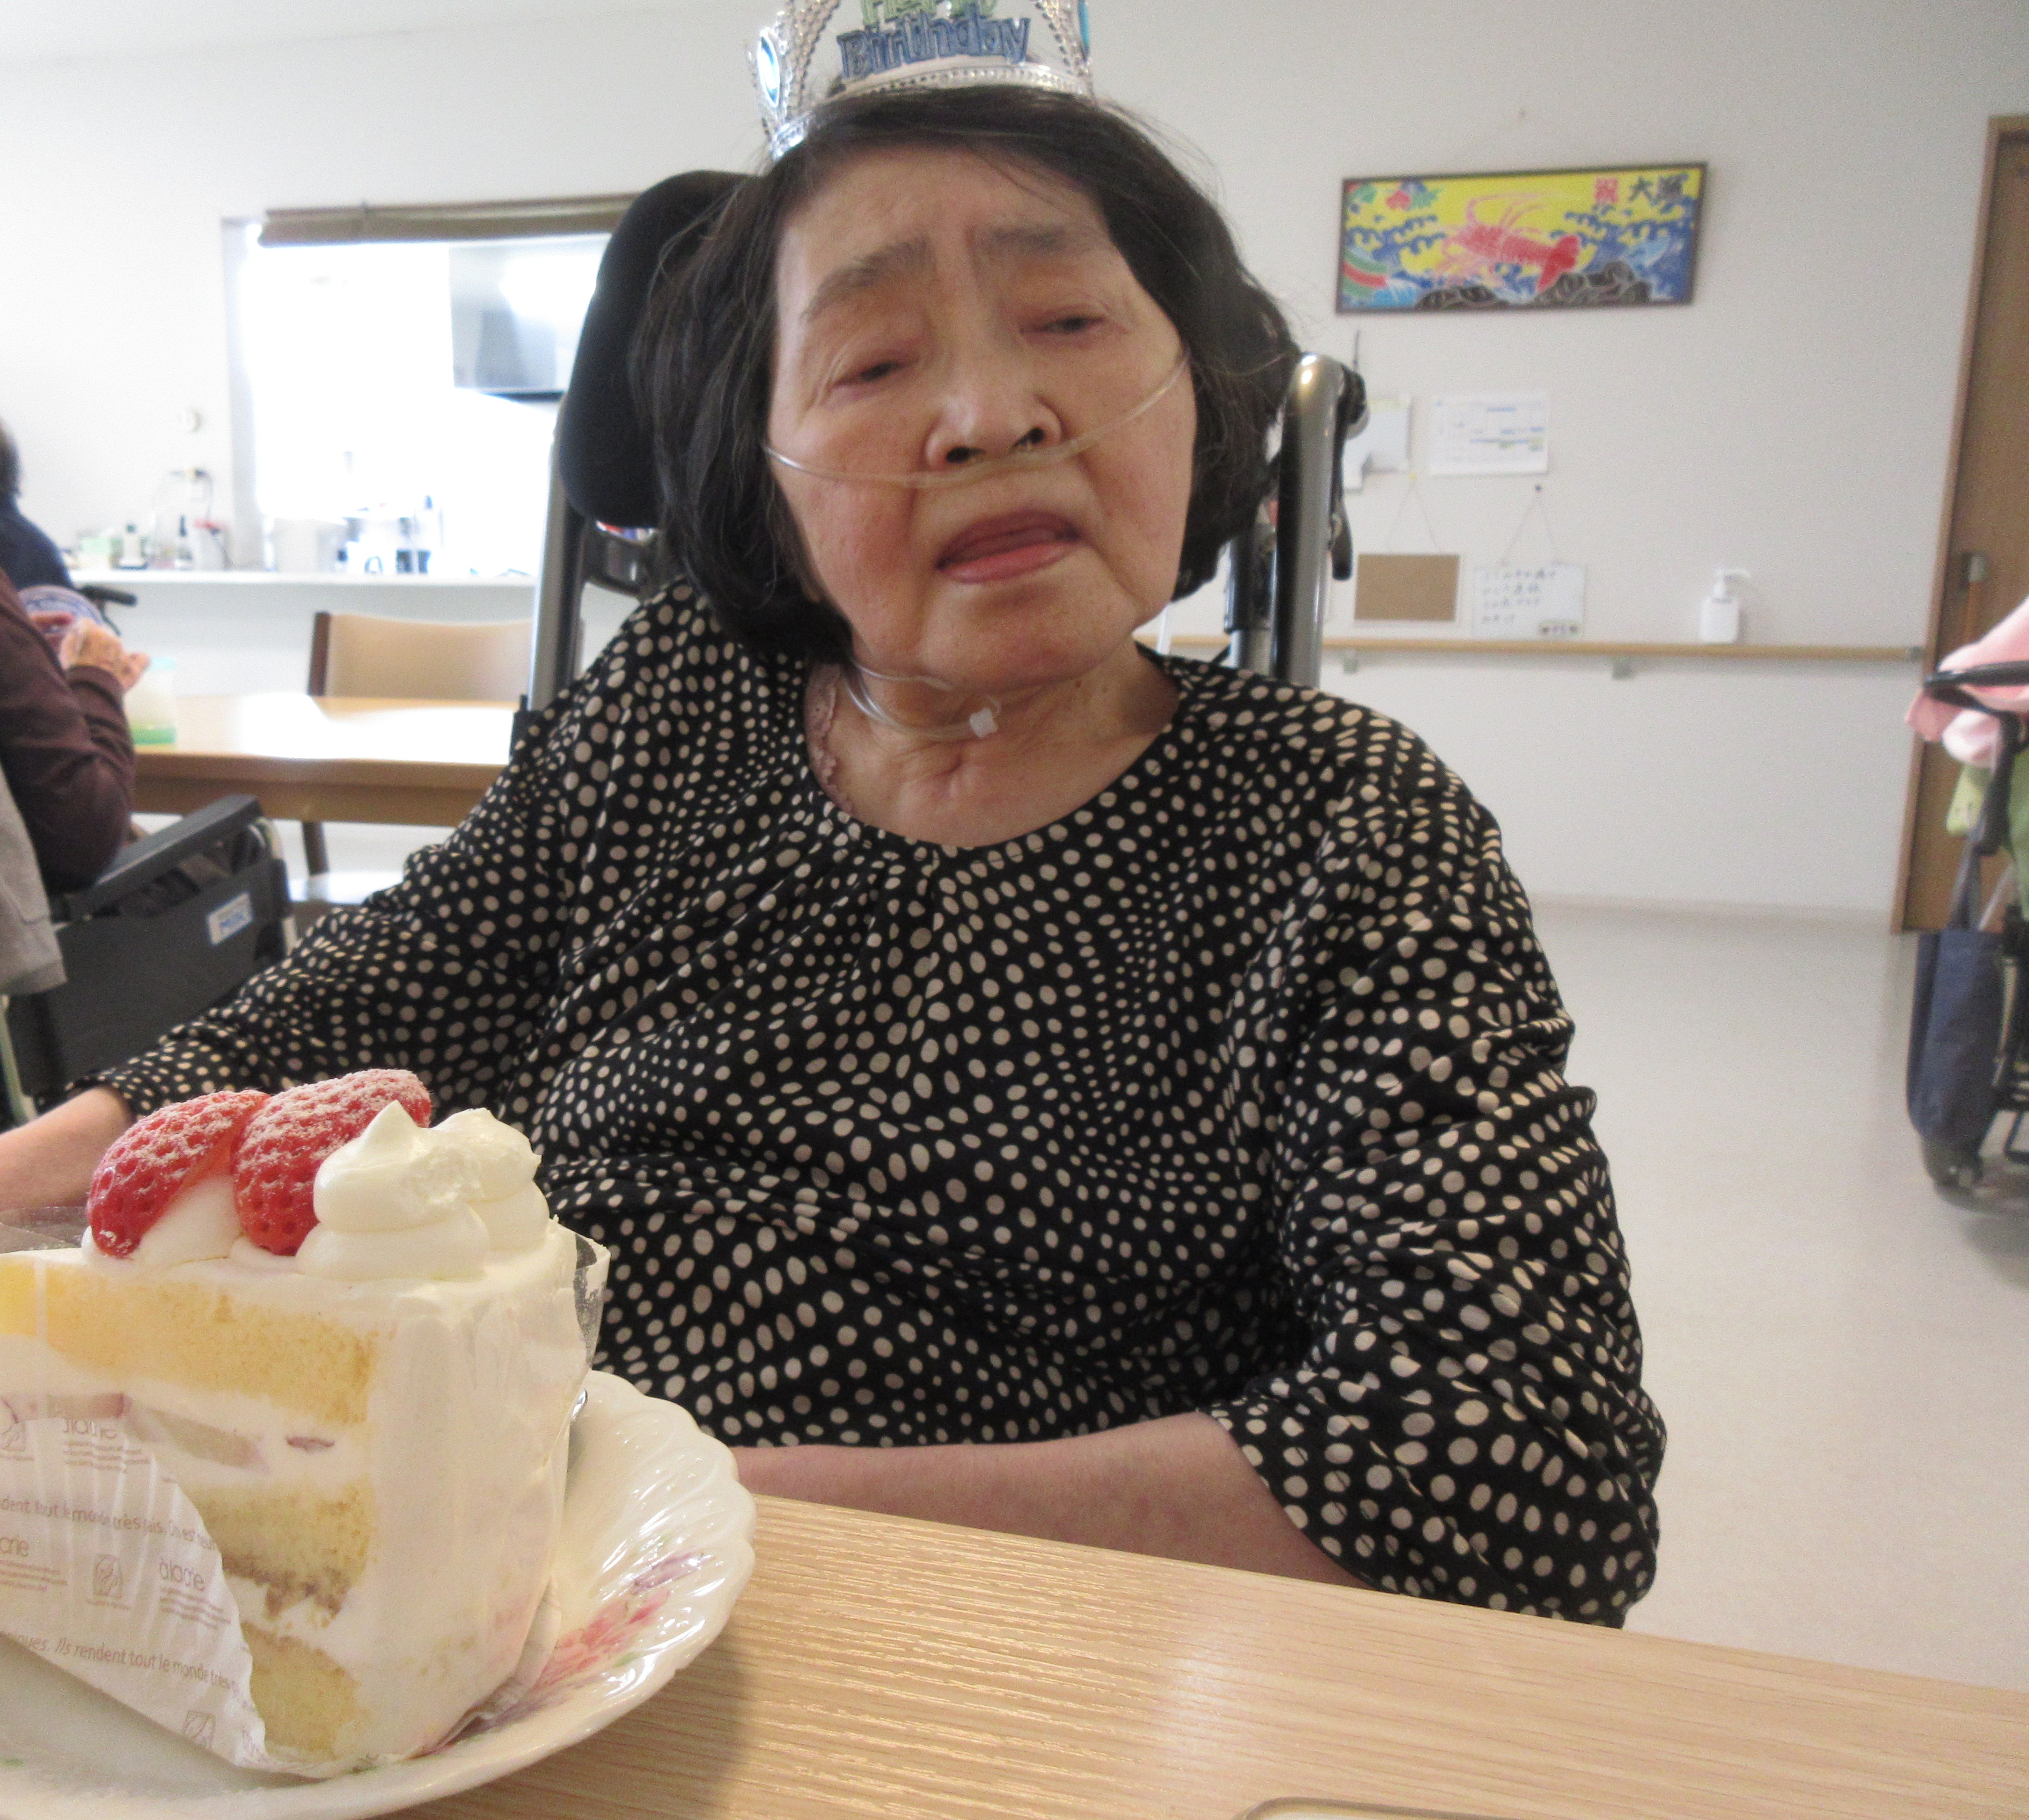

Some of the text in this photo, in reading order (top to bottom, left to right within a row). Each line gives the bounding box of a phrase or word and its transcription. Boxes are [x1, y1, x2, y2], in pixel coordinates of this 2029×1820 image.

[836, 7, 1031, 78] Birthday
[73, 1641, 127, 1665] rendent
[130, 1651, 157, 1670] tout
